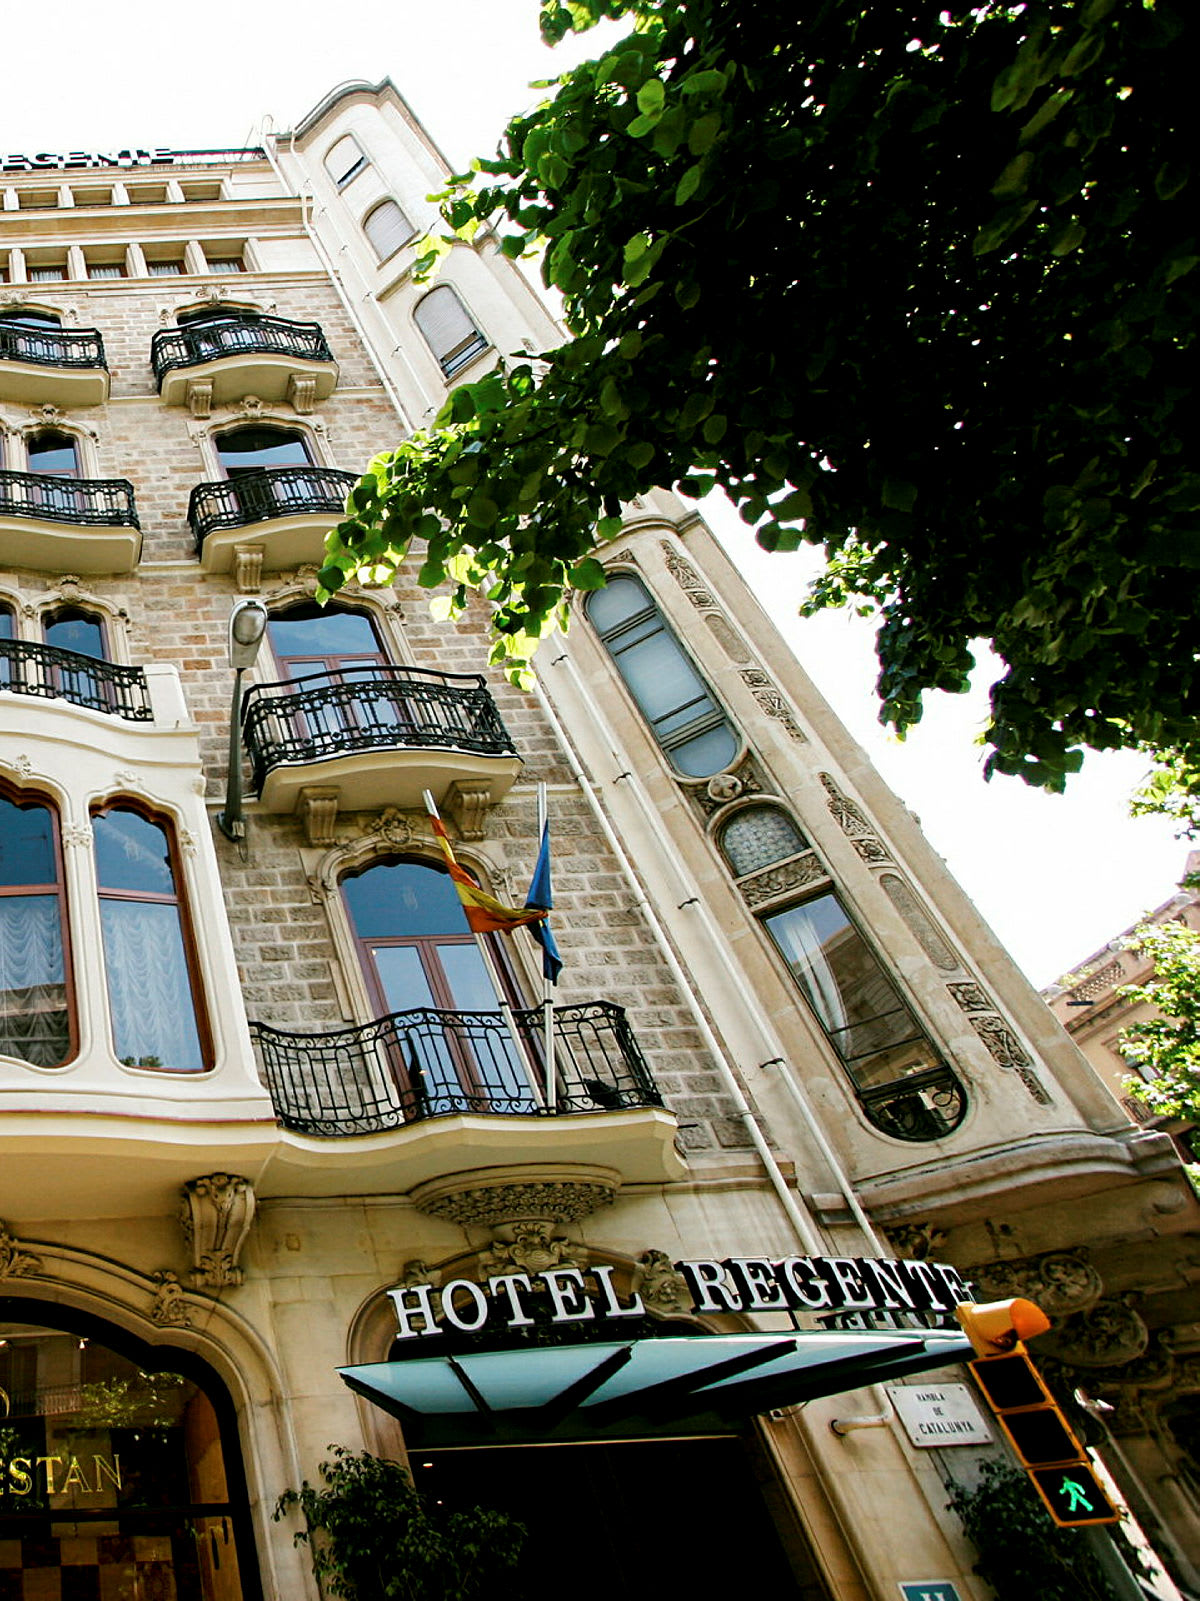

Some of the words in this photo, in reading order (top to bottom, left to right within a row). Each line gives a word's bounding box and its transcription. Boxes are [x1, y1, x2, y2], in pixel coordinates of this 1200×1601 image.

[387, 1266, 646, 1339] HOTEL
[683, 1256, 978, 1312] REGENTE
[918, 1421, 976, 1435] CATALUNYA
